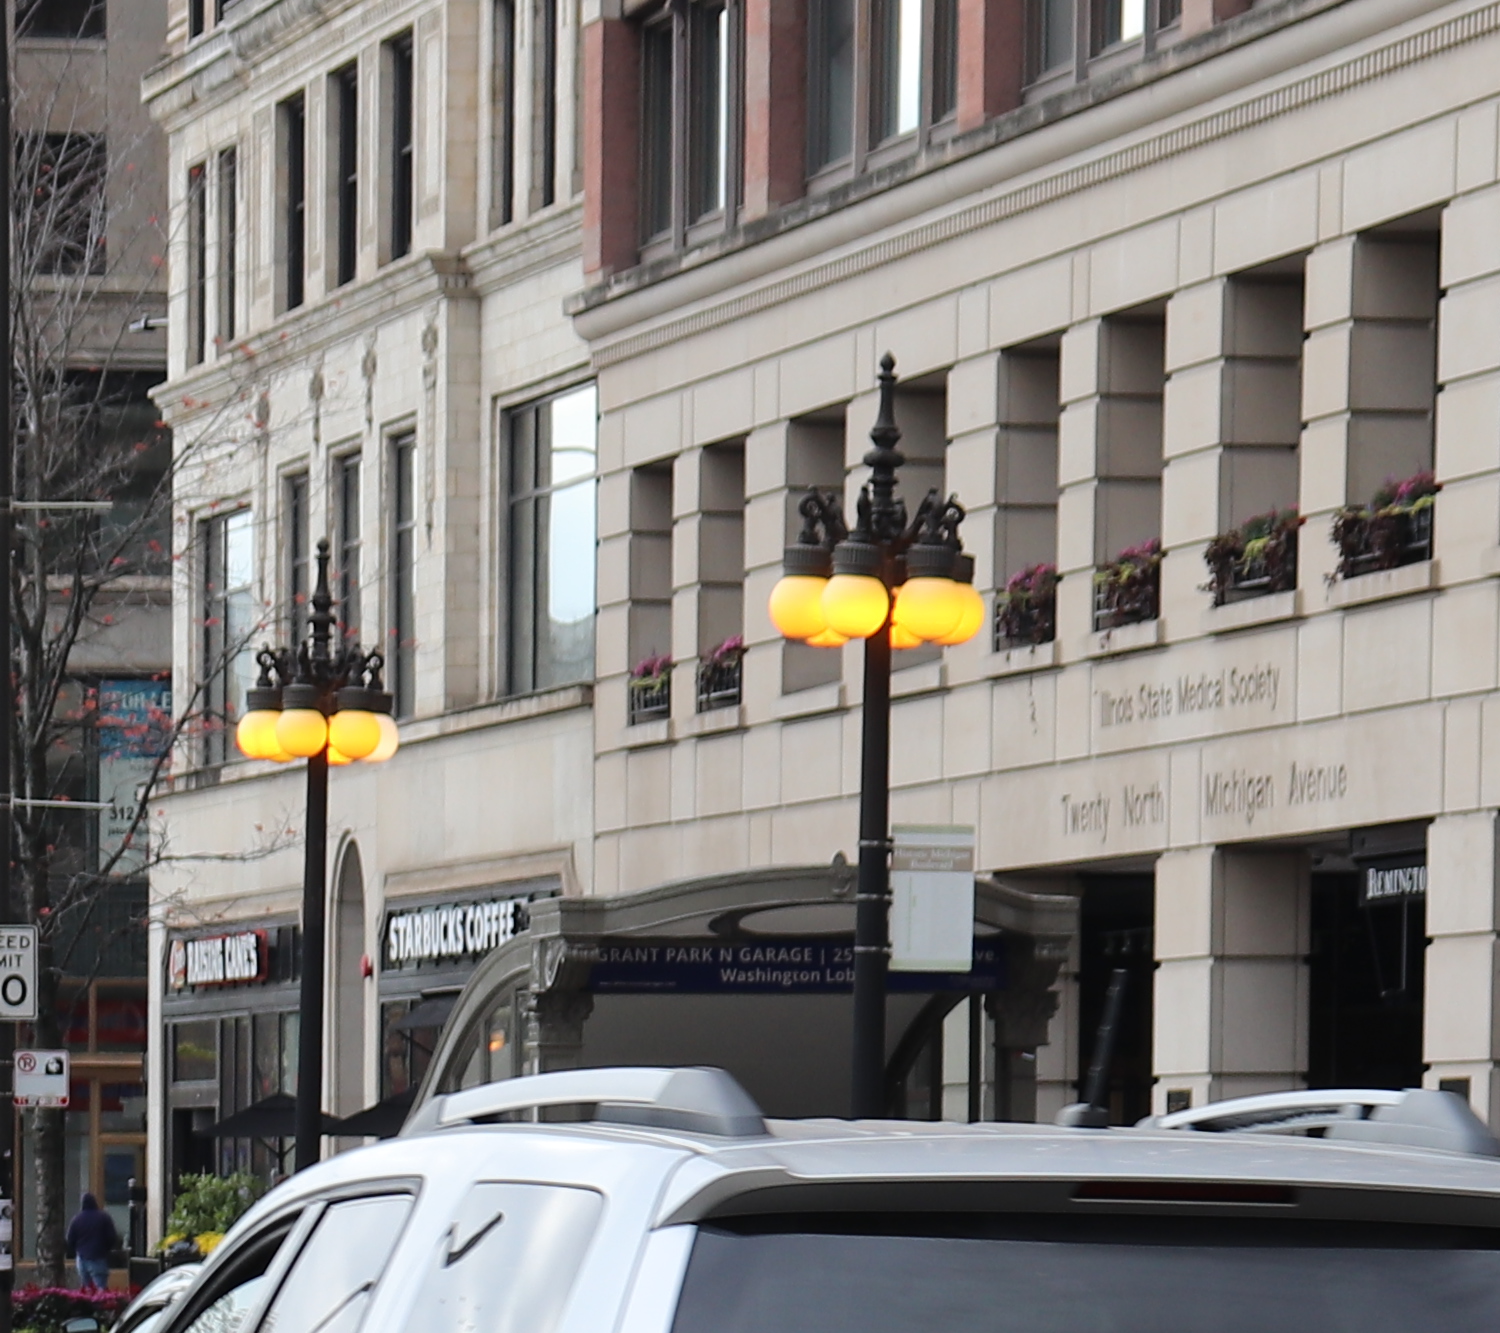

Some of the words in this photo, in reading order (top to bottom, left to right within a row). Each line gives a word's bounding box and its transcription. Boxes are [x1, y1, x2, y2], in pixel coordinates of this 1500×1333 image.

[1139, 683, 1173, 721] State
[1179, 668, 1226, 714] Medical
[1230, 662, 1281, 711] Society
[1062, 791, 1110, 844] Twenty
[1124, 780, 1165, 827] North
[1205, 769, 1274, 825] Michigan
[1288, 761, 1348, 806] Avenue
[1366, 866, 1427, 899] REMINGTO
[389, 907, 464, 962] STARBUCKS
[465, 901, 516, 953] COFFEE
[599, 947, 661, 963] GRANT
[666, 947, 713, 962] PARK
[719, 947, 732, 962] N
[739, 947, 813, 963] GARAGE
[720, 968, 821, 985] Washington
[826, 968, 856, 982] Lob
